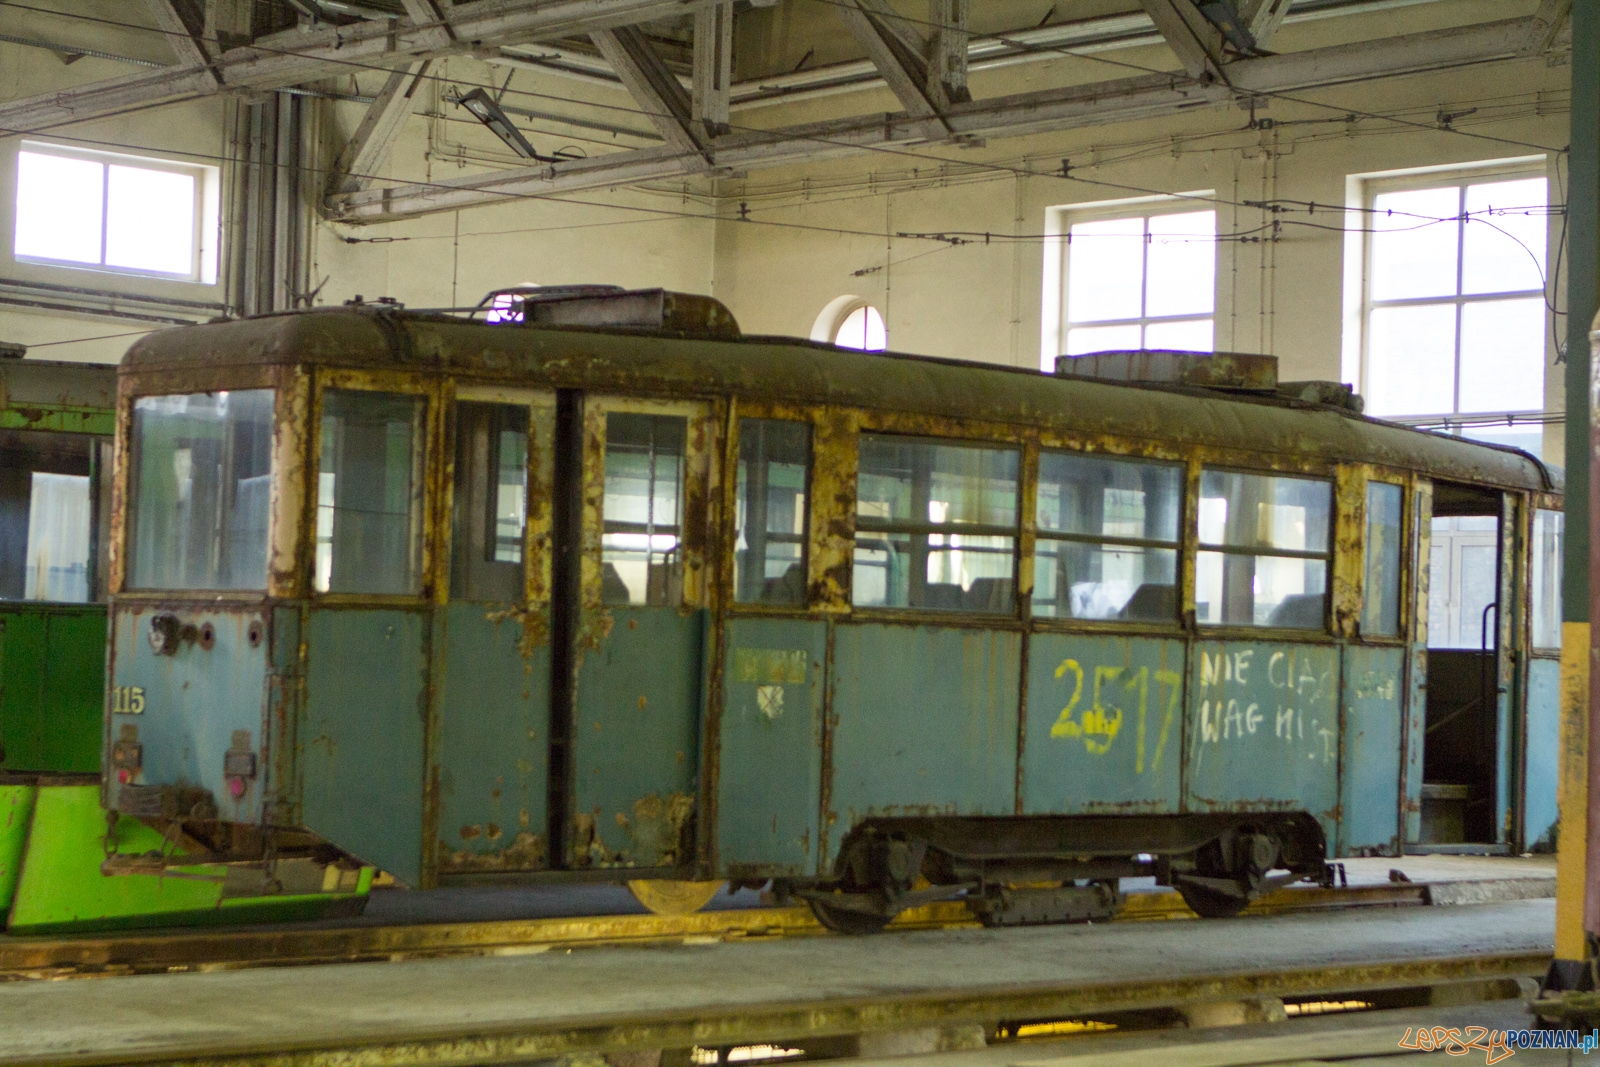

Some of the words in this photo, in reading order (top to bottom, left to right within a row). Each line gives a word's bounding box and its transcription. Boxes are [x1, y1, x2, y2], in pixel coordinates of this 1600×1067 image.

[1200, 649, 1254, 686] NIE
[114, 686, 146, 715] 115
[1200, 699, 1263, 743] WAG
